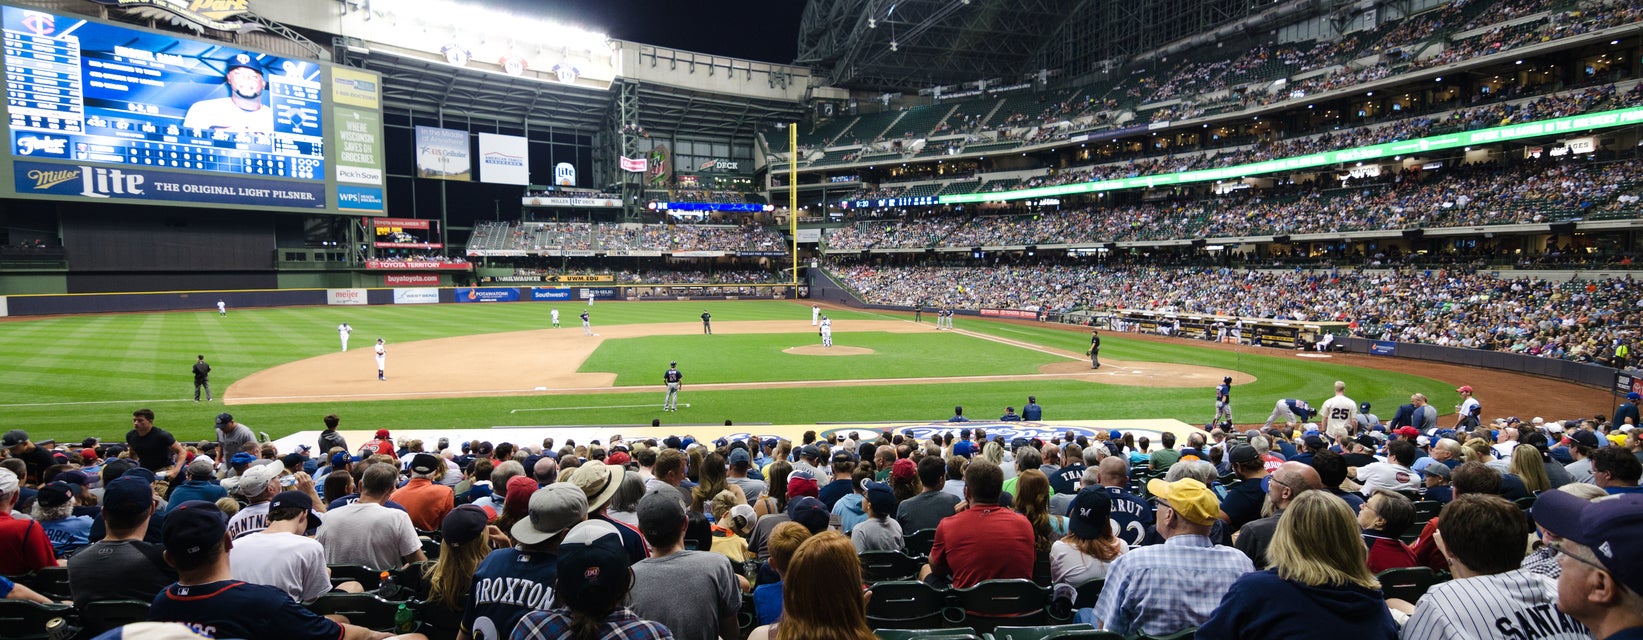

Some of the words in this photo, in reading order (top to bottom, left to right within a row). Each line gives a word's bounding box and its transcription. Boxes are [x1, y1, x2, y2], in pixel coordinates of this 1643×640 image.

[346, 121, 367, 133] WHERE
[340, 130, 374, 144] WISCONSIN
[442, 130, 463, 138] Middle
[344, 141, 363, 153] SAVES
[363, 144, 372, 153] ON
[361, 172, 379, 180] Save
[558, 167, 573, 177] Lite
[28, 169, 80, 189] Miller
[78, 166, 145, 198] Lite
[154, 182, 180, 192] THE
[182, 184, 236, 196] ORIGINAL
[238, 187, 270, 198] LIGHT
[272, 190, 315, 201] PILSNER.
[339, 193, 358, 202] WPS
[570, 198, 582, 206] Lite
[856, 200, 869, 208] 9:20
[388, 275, 437, 283] buyatoyota.com
[335, 290, 359, 300] meijer
[1331, 408, 1350, 420] 25
